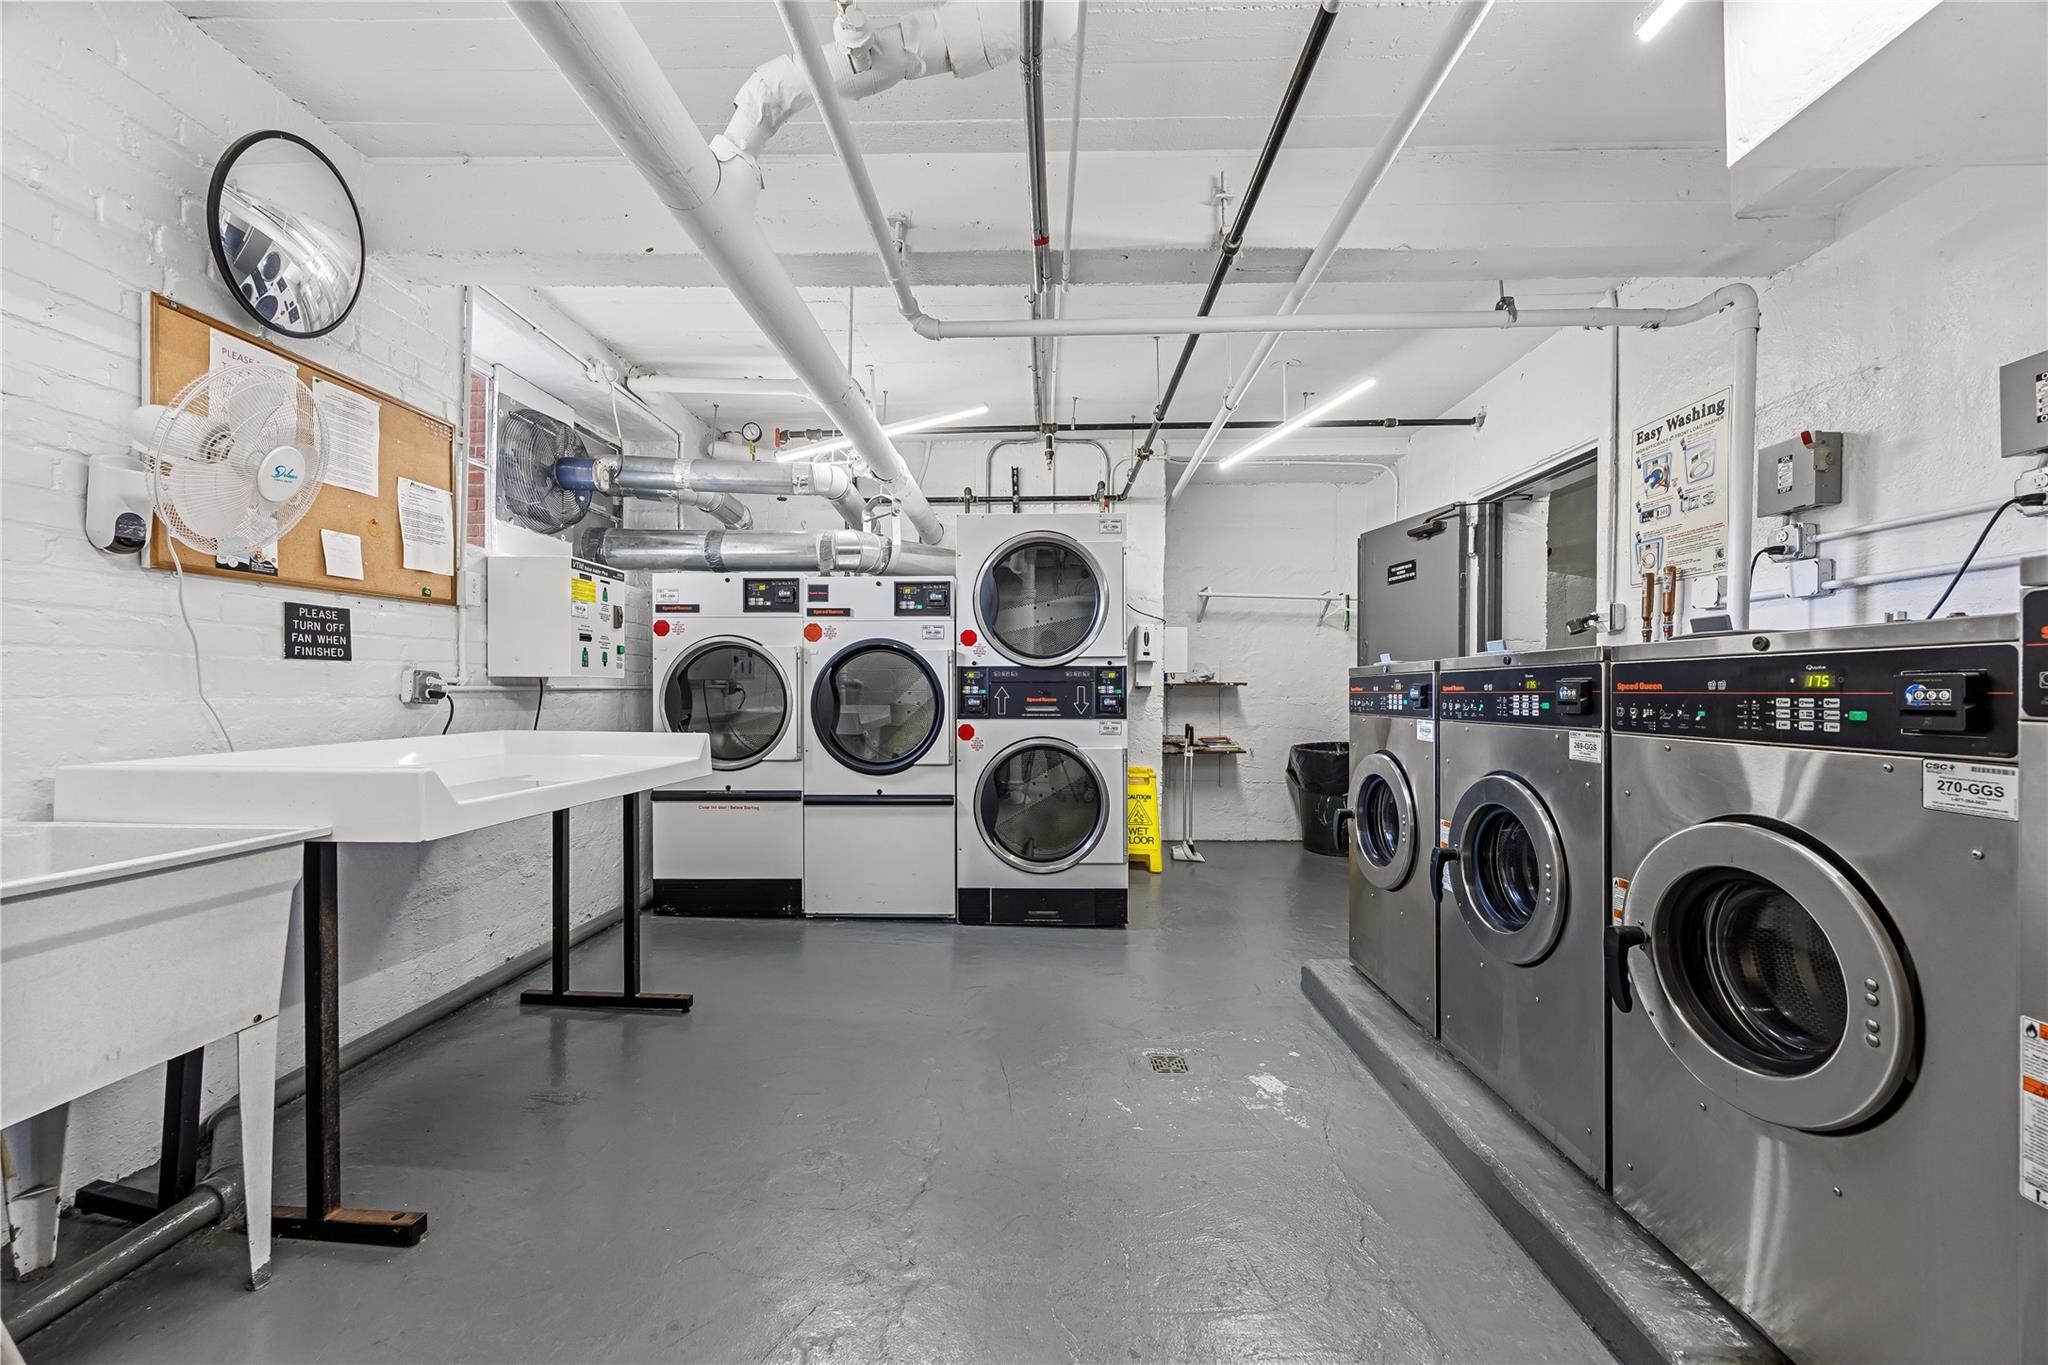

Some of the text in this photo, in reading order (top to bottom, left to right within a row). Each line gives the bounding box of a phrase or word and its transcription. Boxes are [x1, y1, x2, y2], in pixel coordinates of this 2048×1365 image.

[1636, 399, 1725, 446] Easy Washing
[299, 607, 338, 620] PLEASE
[292, 619, 345, 633] TURN OFF
[291, 633, 346, 645] FAN WHEN
[294, 646, 344, 658] FINISHED
[1617, 682, 1663, 691] Speed Queen
[1807, 675, 1830, 687] 175
[1925, 762, 1948, 770] CSC
[1937, 780, 2004, 798] 270-GGS
[1128, 827, 1149, 835] WET
[1128, 836, 1154, 844] LOOR
